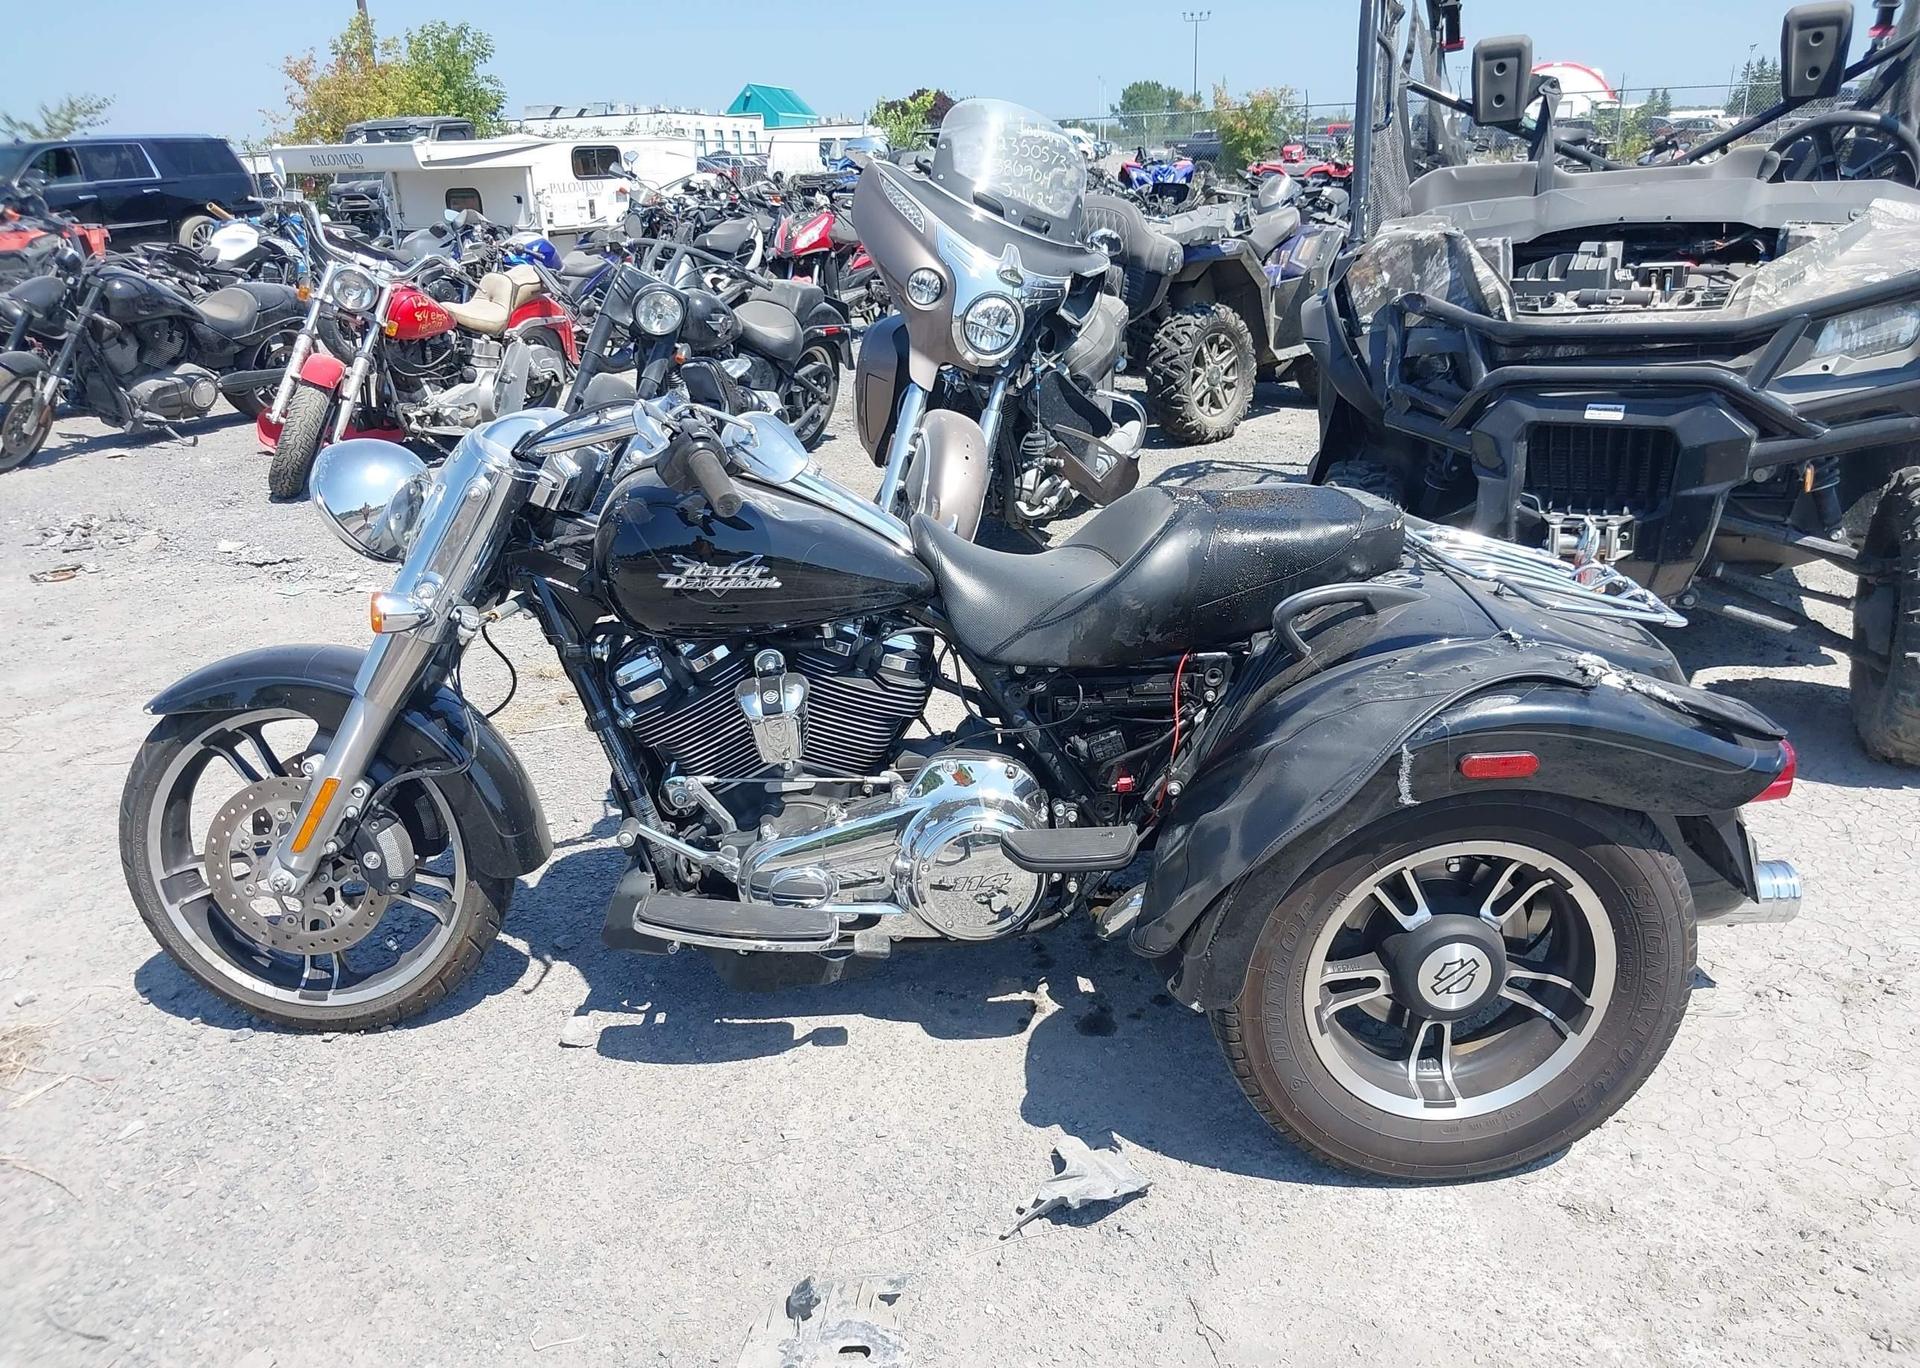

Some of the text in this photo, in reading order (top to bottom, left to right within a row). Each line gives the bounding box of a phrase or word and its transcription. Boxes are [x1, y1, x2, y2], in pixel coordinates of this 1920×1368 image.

[310, 152, 364, 167] PALOMINO
[549, 181, 604, 194] PALOMINO
[657, 573, 782, 592] Davidson
[953, 872, 1012, 892] 114
[1263, 892, 1317, 1064] DUNLOP
